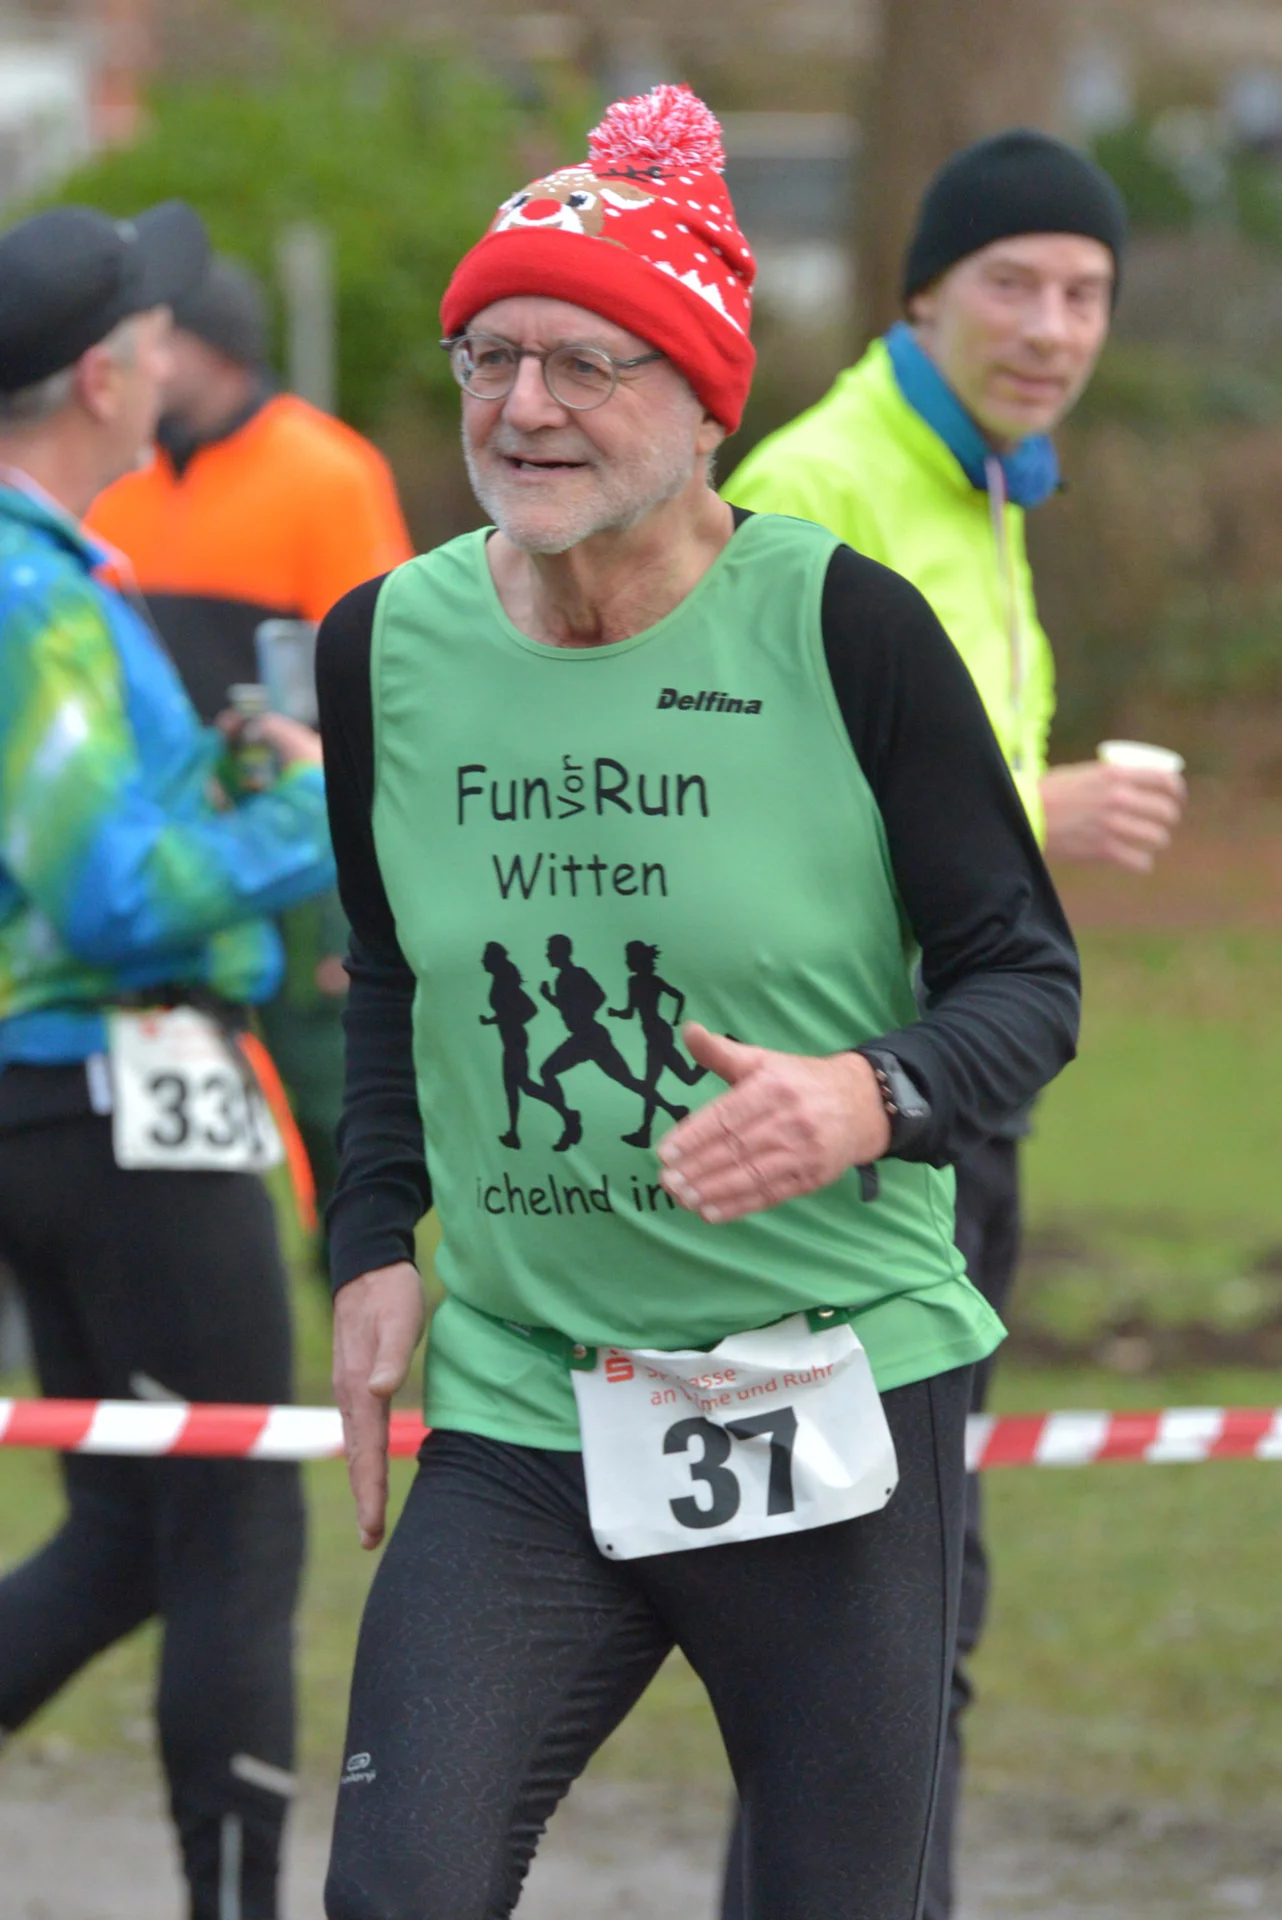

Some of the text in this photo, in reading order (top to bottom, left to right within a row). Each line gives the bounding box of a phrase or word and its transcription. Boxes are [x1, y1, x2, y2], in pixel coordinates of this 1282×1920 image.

[656, 688, 763, 715] Delfina
[457, 754, 709, 825] Fun vor Run
[492, 852, 667, 900] Witten
[650, 1385, 677, 1406] an
[736, 1377, 778, 1401] und
[783, 1363, 834, 1389] Ruhr
[662, 1405, 799, 1530] 37
